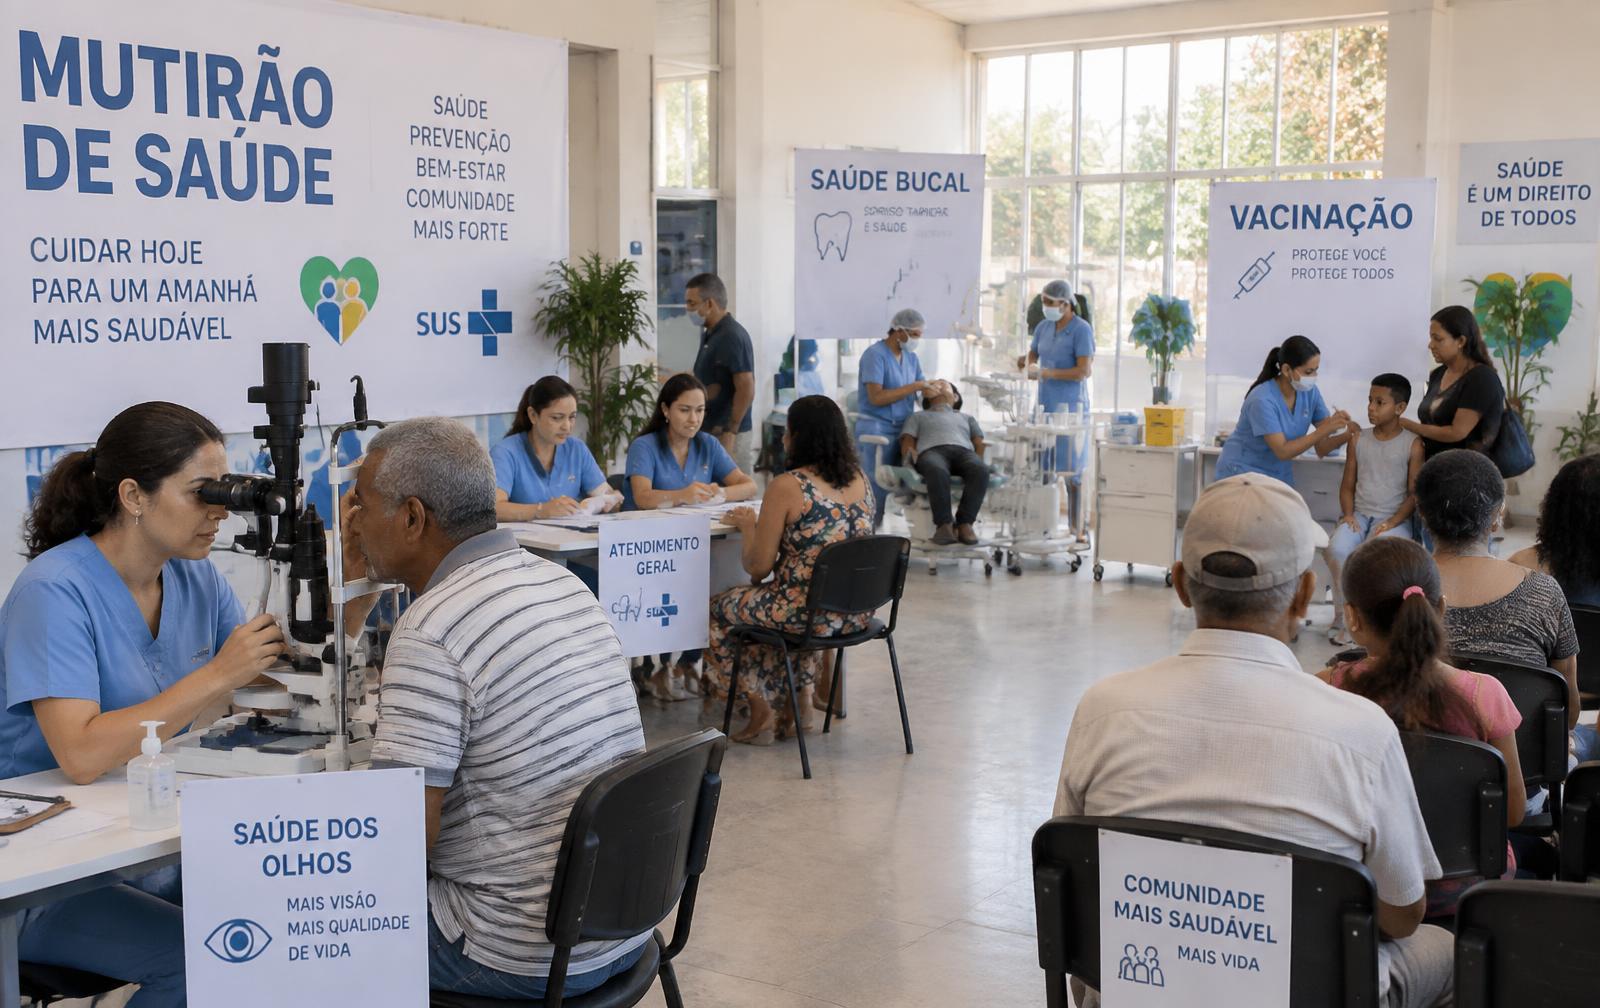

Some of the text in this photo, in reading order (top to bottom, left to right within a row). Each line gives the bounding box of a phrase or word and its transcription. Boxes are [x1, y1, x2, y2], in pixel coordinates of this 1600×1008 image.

[18, 29, 335, 129] MUTIRÃO
[23, 123, 335, 206] DE SAÚDE
[416, 157, 506, 182] BEM-ESTAR
[1497, 157, 1564, 179] SAÚDE
[811, 165, 971, 192] SAÚDE BUCAL
[406, 188, 515, 212] COMUNIDADE
[1468, 184, 1591, 202] É UM DIREITO
[1230, 197, 1413, 237] VACINAÇÃO
[1482, 210, 1576, 226] DE TODOS
[414, 220, 509, 241] MAIS FORTE
[30, 237, 203, 264] CUIDAR HOJE
[1292, 248, 1348, 261] PROTEGE
[1292, 268, 1394, 279] PROTEGE TODOS
[32, 274, 257, 304] PARA UM AMANHÁ
[34, 311, 231, 344] MAIS SAUDÁVEL
[416, 311, 461, 337] SUS
[609, 537, 699, 558] ATENDIMENTO
[637, 560, 677, 575] GERAL
[234, 815, 378, 845] SAÚDE DOS
[262, 852, 352, 877] OLHOS
[287, 896, 325, 912] MAIS
[1124, 874, 1265, 912] COMUNIDADE
[288, 916, 410, 936] MAIS QUALIDADE
[1114, 900, 1277, 944] MAIS SAUDÁVEL
[288, 943, 351, 961] DE VIDA
[1178, 945, 1260, 972] MAIS VIDA
